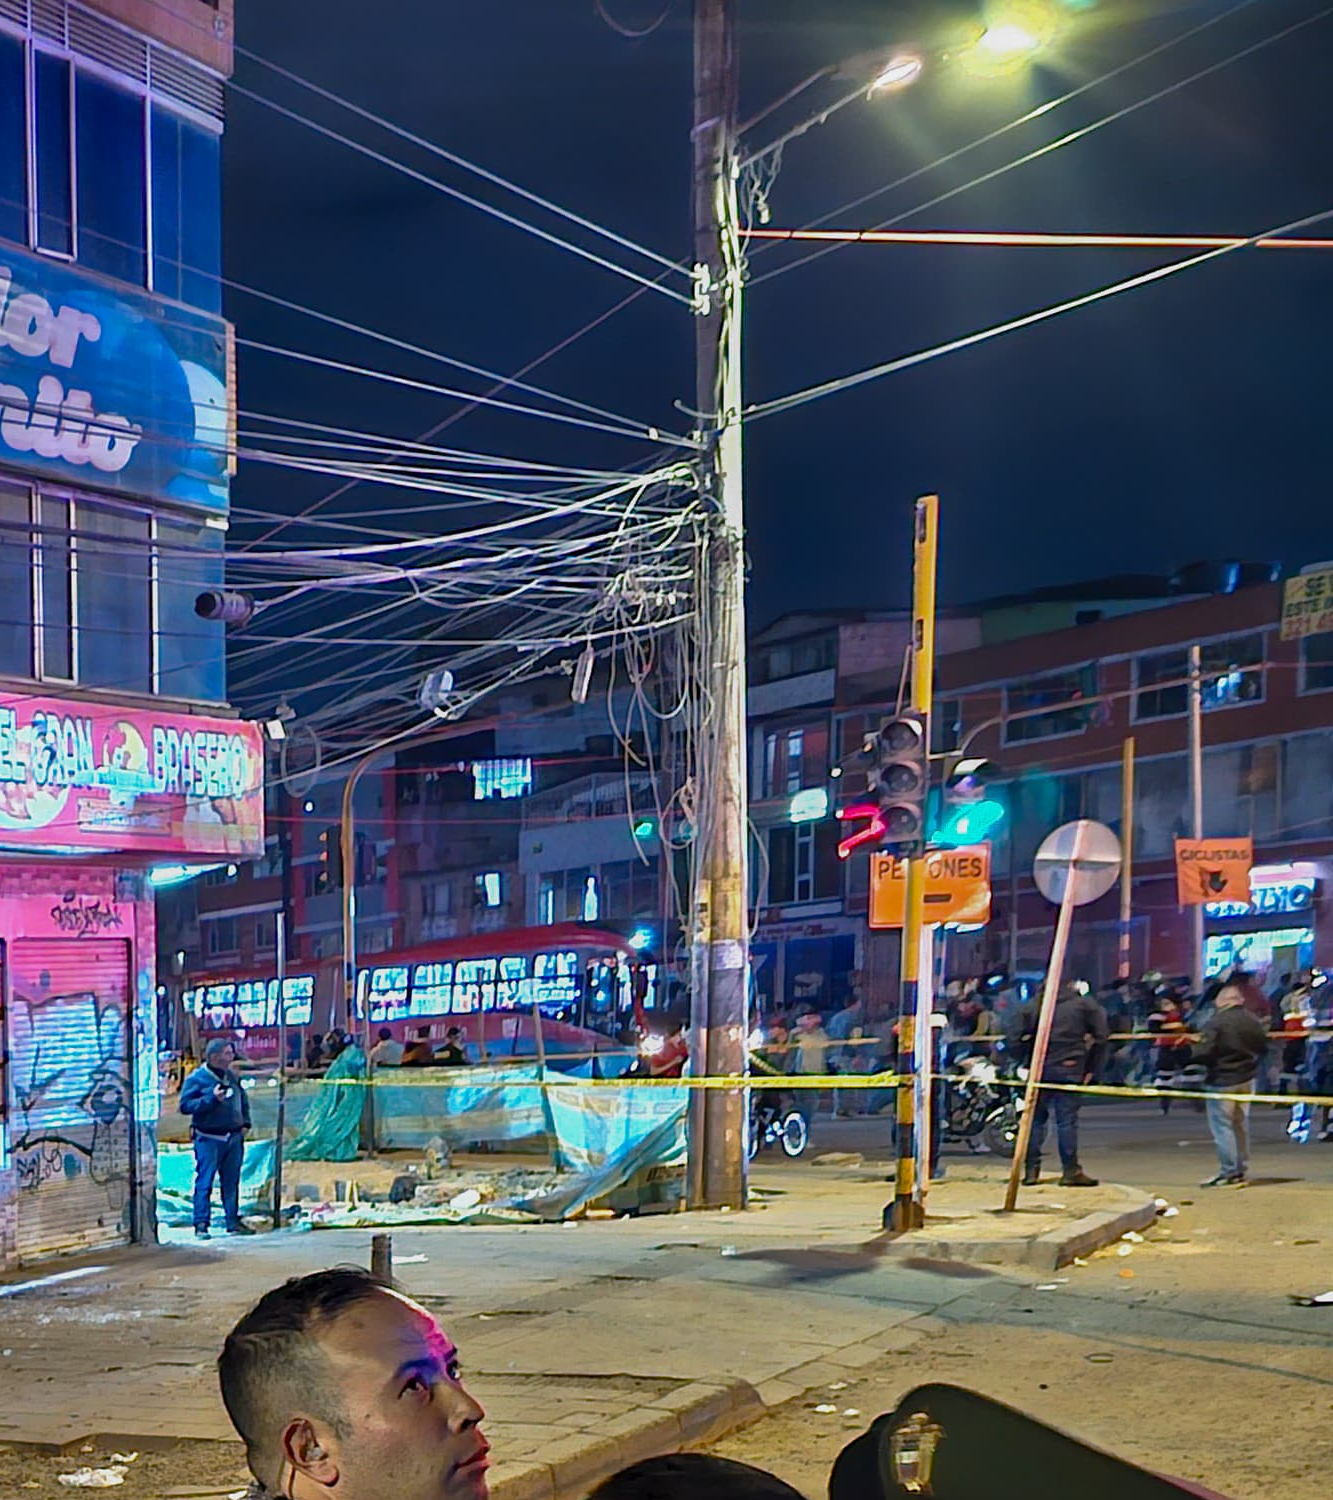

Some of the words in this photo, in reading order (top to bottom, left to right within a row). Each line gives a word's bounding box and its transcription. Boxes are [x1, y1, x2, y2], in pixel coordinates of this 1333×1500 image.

[33, 711, 96, 788] GRAN
[153, 725, 246, 801] BRASERO
[878, 857, 982, 880] PEONES
